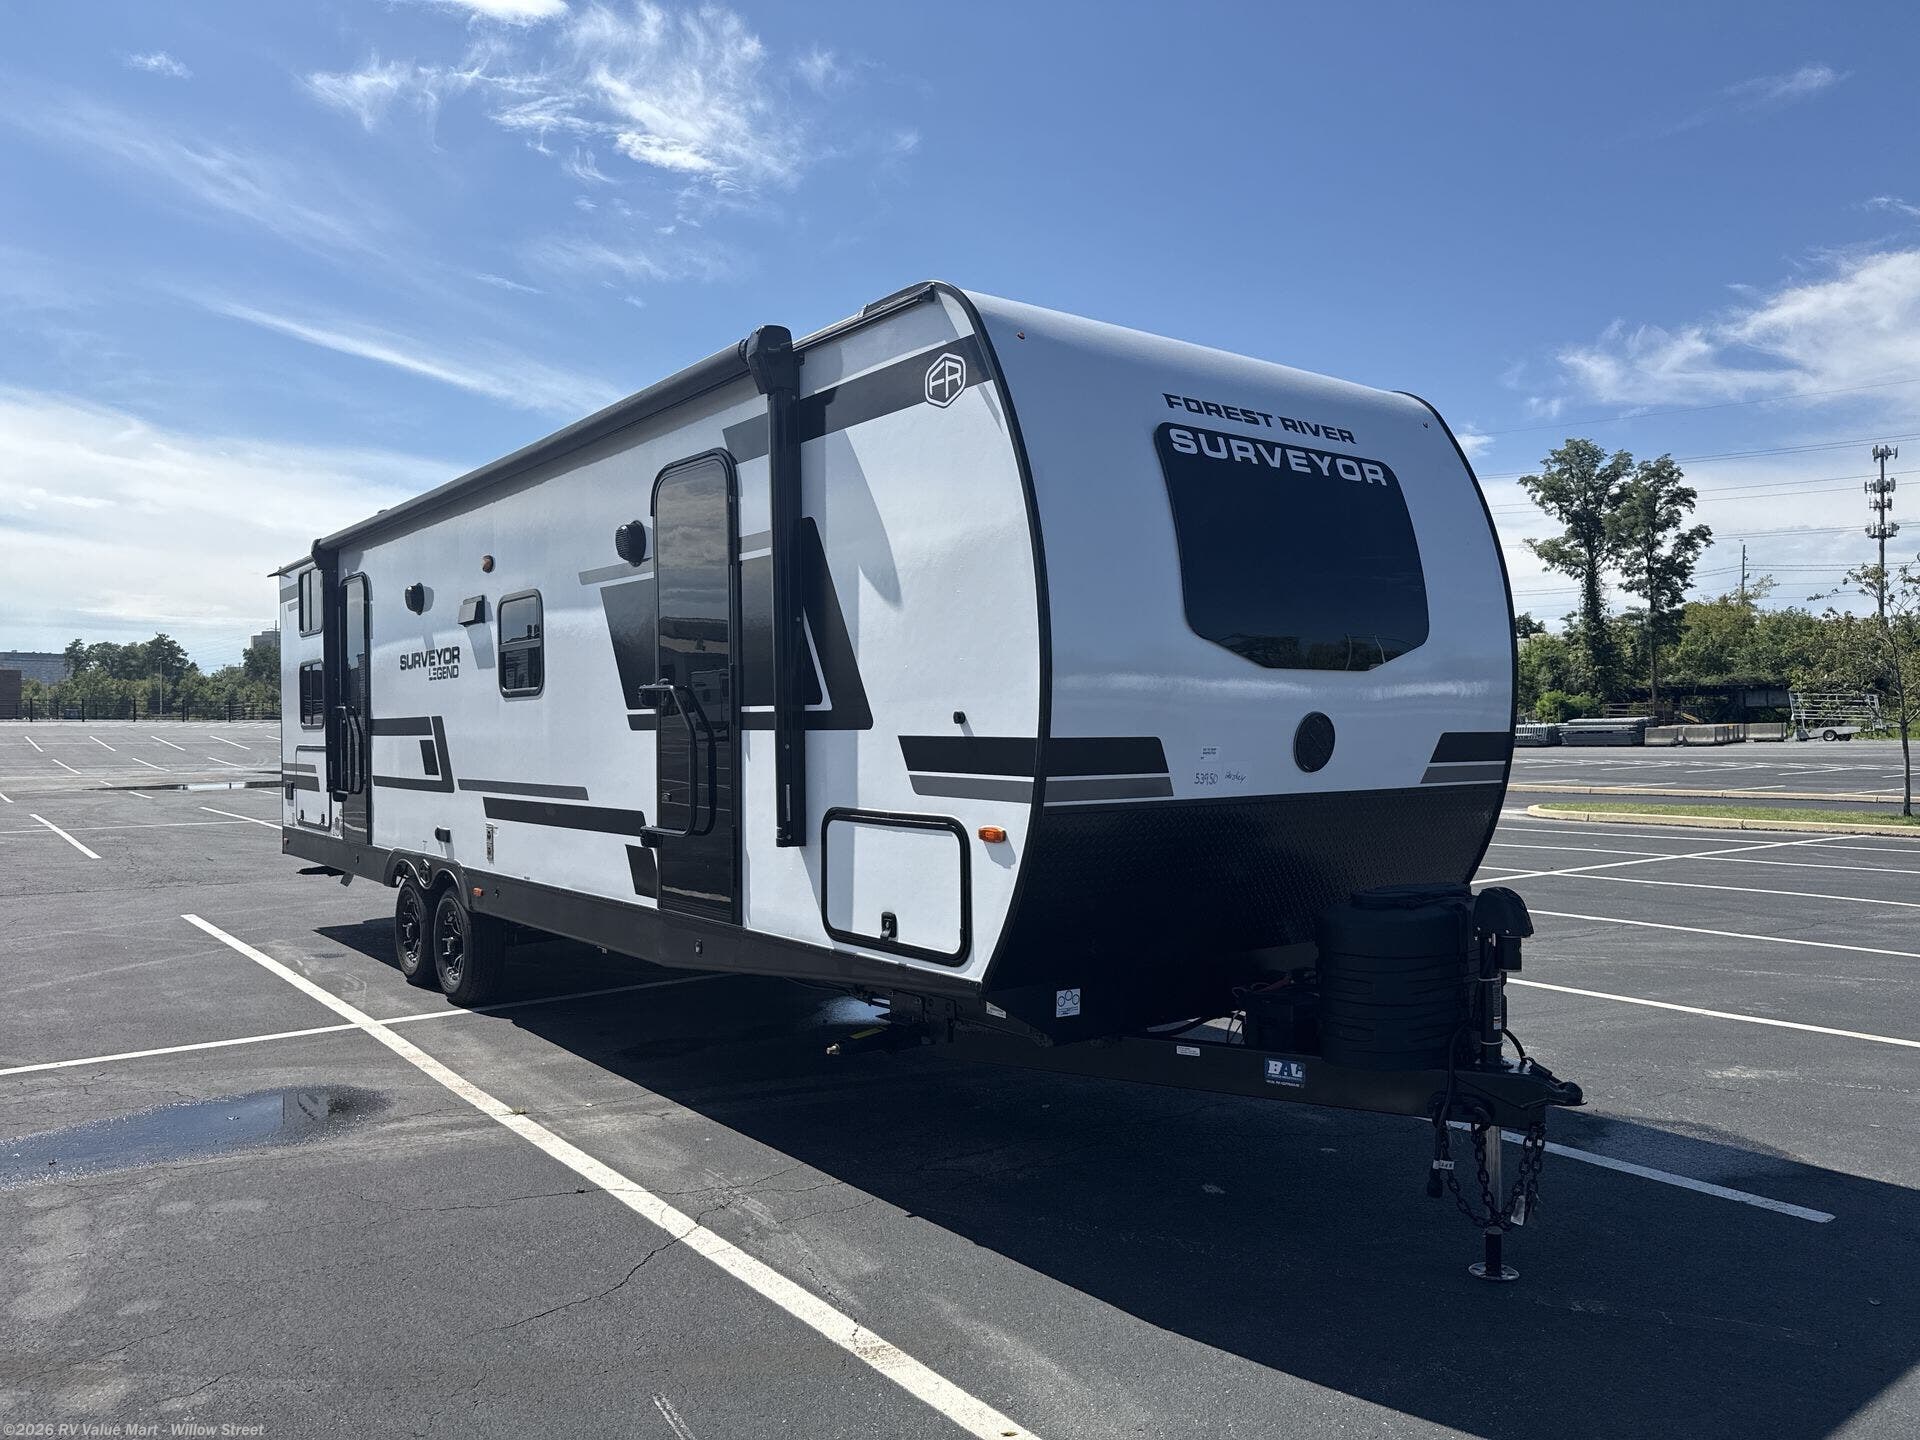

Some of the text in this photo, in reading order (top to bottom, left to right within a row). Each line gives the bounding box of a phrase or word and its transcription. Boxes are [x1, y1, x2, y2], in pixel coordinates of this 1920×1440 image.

[1162, 393, 1357, 445] FOREST RIVER
[1169, 428, 1388, 487] SURVEYOR
[400, 646, 460, 671] SURVEYOR
[428, 664, 459, 681] LEGEND
[1268, 1060, 1303, 1078] BAL
